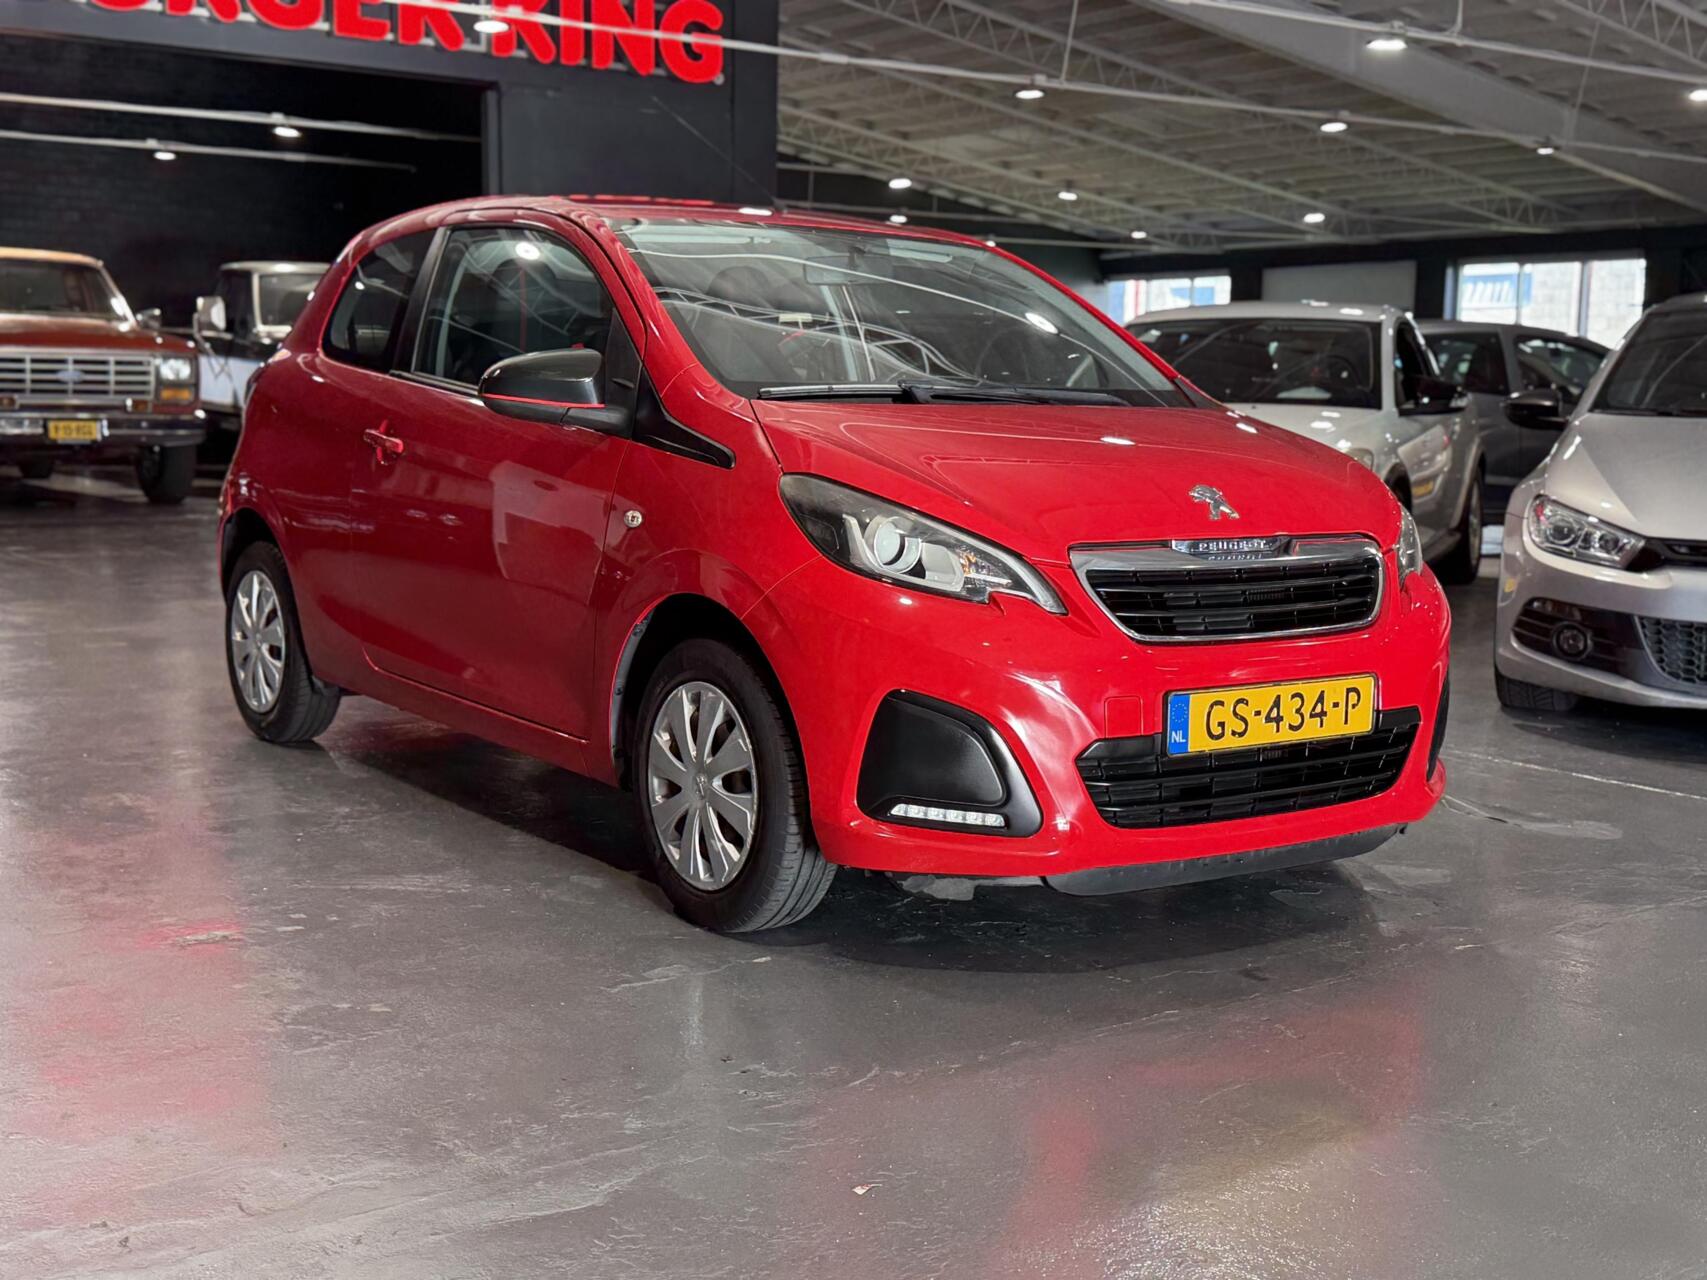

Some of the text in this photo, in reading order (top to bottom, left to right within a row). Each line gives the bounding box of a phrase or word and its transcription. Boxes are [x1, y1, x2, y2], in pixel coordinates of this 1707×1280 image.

[491, 0, 723, 83] KING
[1171, 687, 1361, 743] NL GS-434-P
